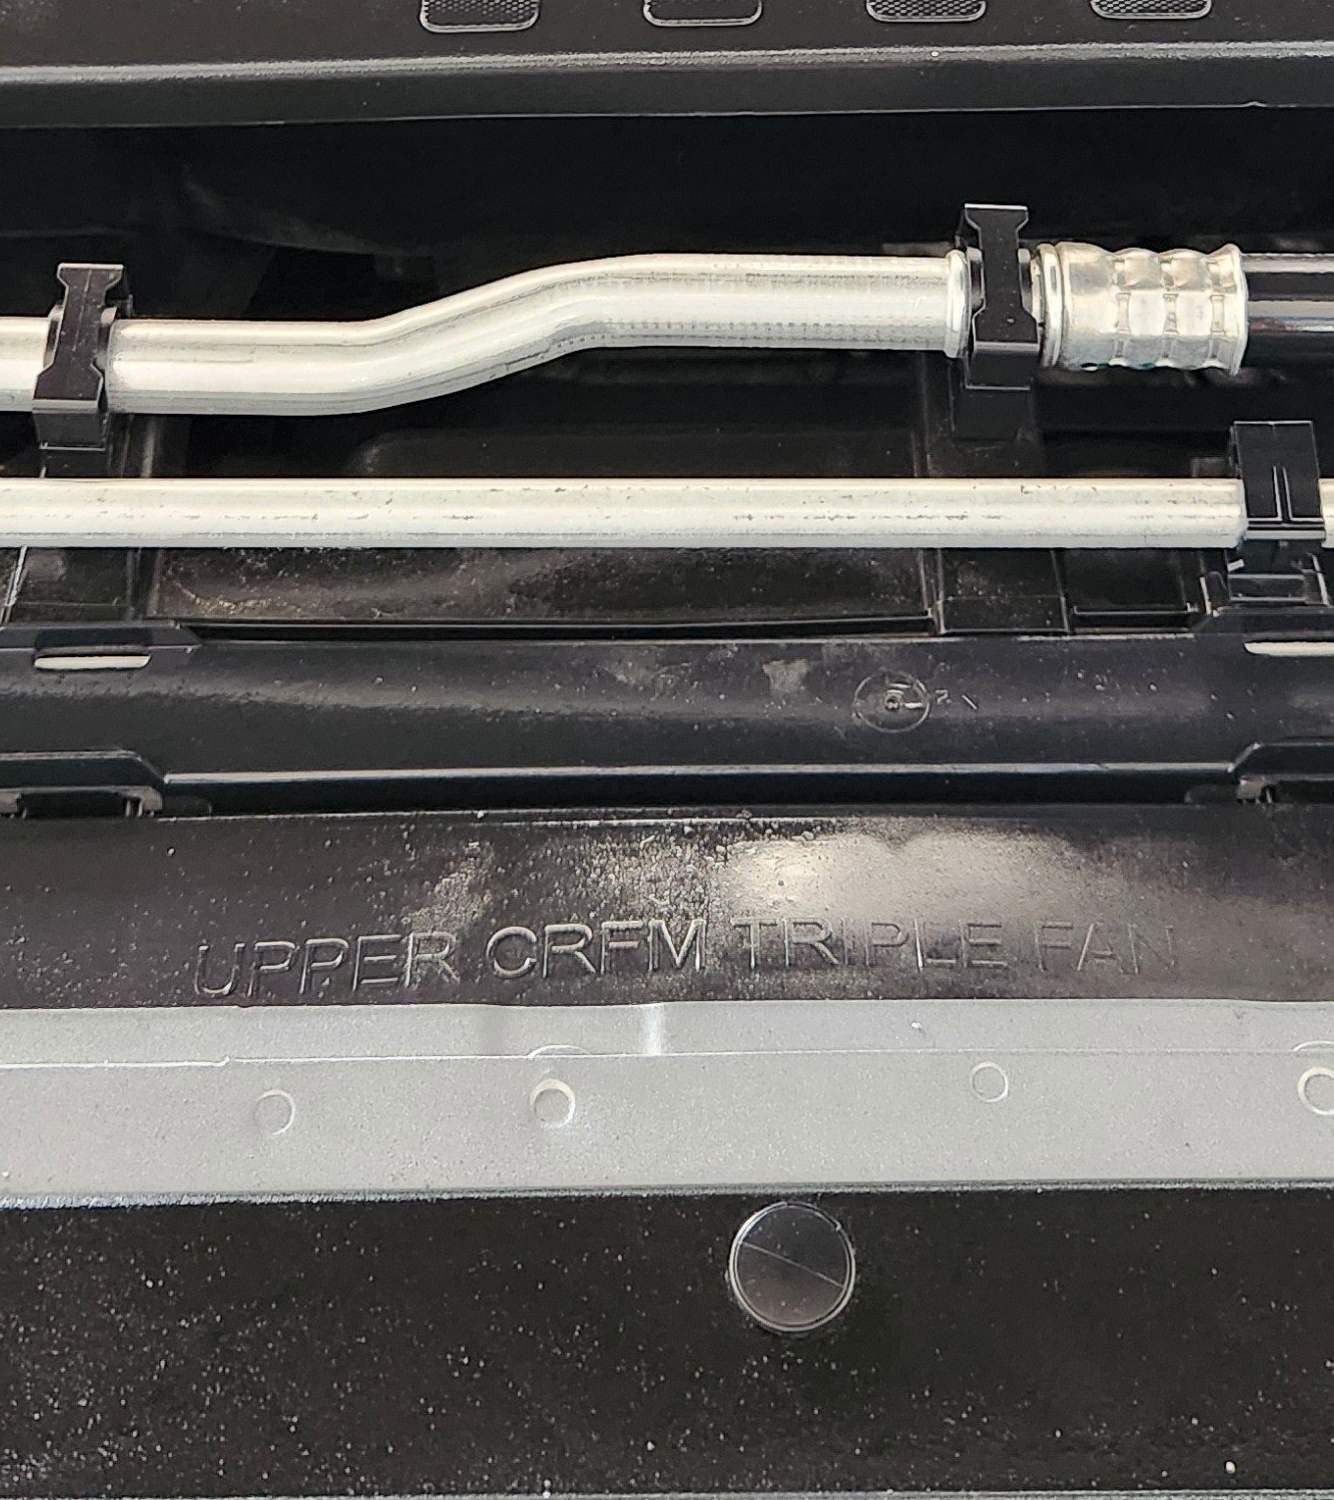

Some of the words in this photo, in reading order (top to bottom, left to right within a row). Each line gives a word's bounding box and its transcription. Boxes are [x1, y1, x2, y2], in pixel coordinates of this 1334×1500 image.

[194, 931, 460, 998] UPPER
[486, 918, 707, 980] CRFM
[731, 918, 1006, 970] TRIPLE
[1032, 920, 1176, 976] FAN
